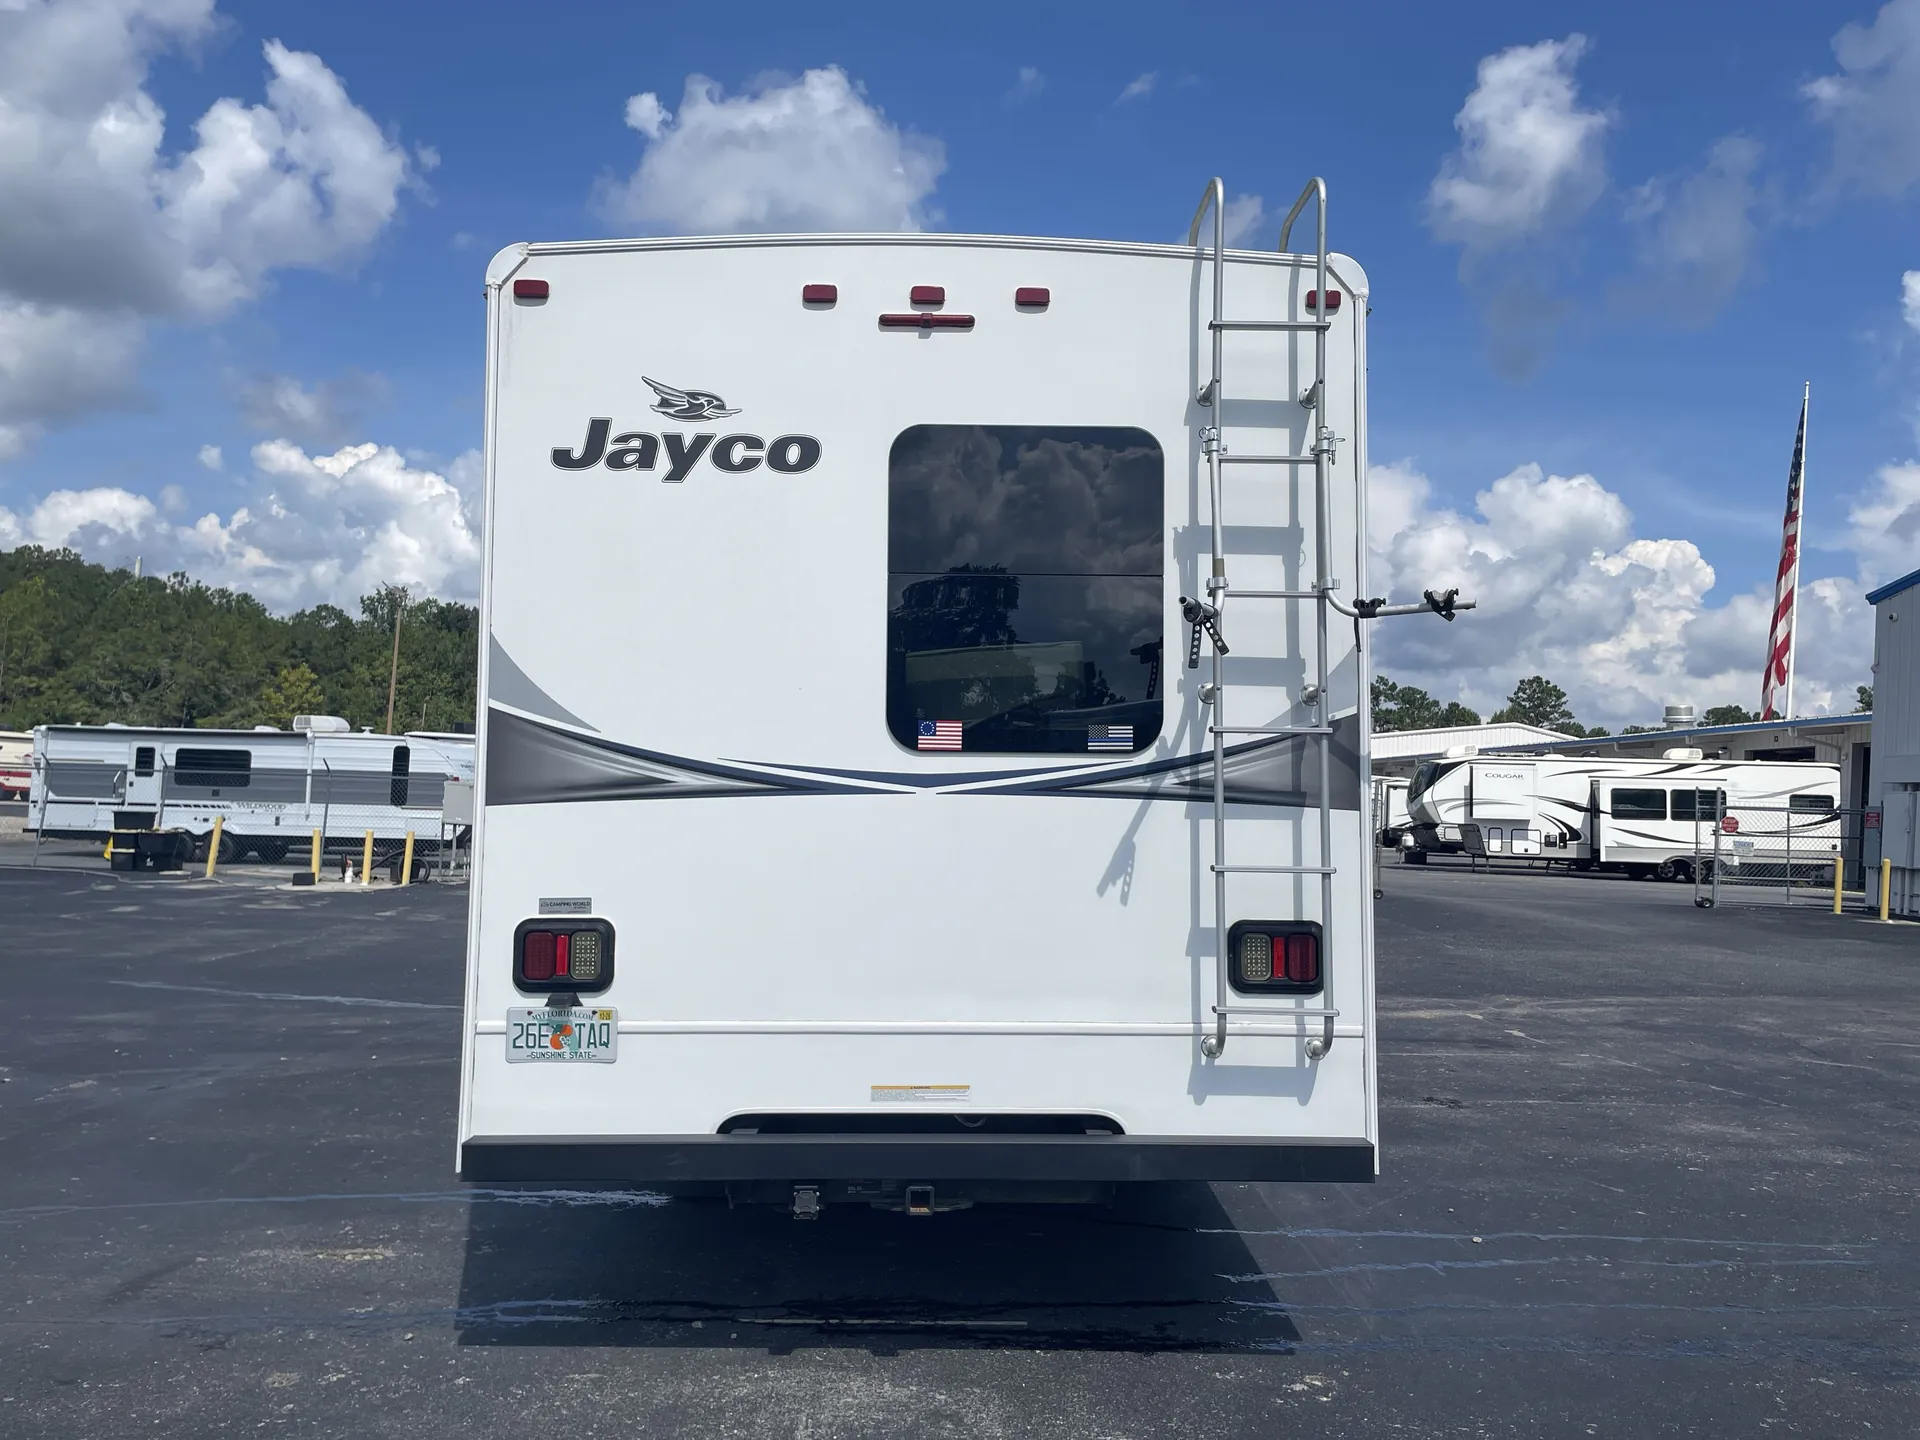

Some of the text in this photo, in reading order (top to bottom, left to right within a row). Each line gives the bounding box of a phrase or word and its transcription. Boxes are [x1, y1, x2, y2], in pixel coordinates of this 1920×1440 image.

[550, 416, 822, 483] Jayco
[532, 1008, 593, 1020] MYFLORIDA.COM
[512, 1023, 611, 1049] 26E TAQ
[530, 1051, 592, 1059] SUNSHINE STATE
